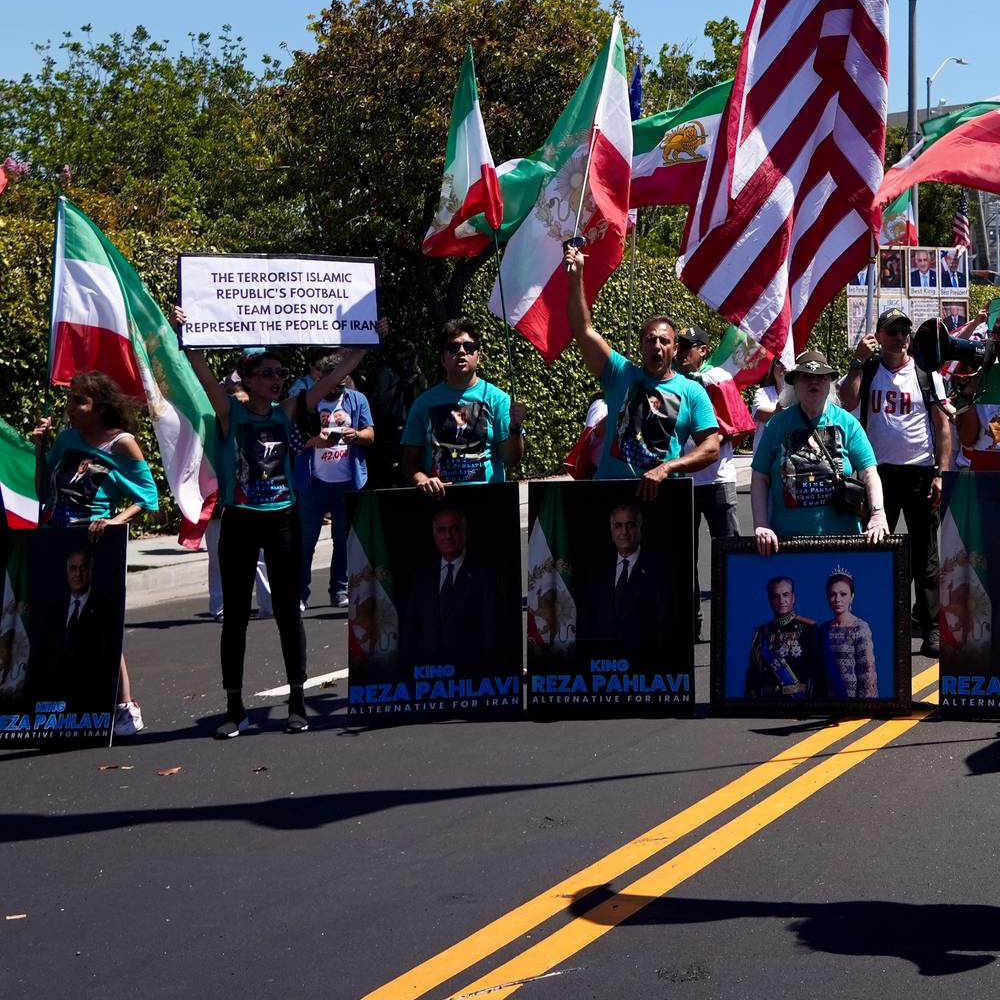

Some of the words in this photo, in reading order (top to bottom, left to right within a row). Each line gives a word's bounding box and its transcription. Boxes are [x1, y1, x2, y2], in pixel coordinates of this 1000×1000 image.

[211, 272, 234, 283] THE
[237, 272, 303, 283] TERRORIST
[306, 272, 352, 283] ISLAMIC
[216, 288, 287, 299] REPUBLIC'S
[290, 288, 349, 299] FOOTBALL
[236, 304, 271, 315] TEAM
[274, 304, 307, 315] DOES
[310, 304, 334, 314] NOT
[185, 321, 256, 333] REPRESENT
[259, 321, 282, 331] THE
[285, 320, 328, 331] PEOPLE
[332, 320, 348, 330] OF
[350, 320, 377, 331] IRAN
[872, 390, 912, 414] USA
[414, 664, 456, 680] KING
[591, 659, 630, 672] KING
[350, 683, 411, 704] REZA
[415, 676, 519, 700] PAHLAVI
[532, 674, 588, 692] REZA
[592, 674, 690, 693] PAHLAVI
[532, 694, 620, 703] ALTERNATIVE
[658, 694, 690, 702] IRAN
[350, 702, 445, 715] ALTERNATIVE
[452, 699, 478, 708] FOR
[486, 697, 519, 706] IRAN
[0, 714, 30, 730] EZA
[34, 712, 110, 730] PAHLAVI
